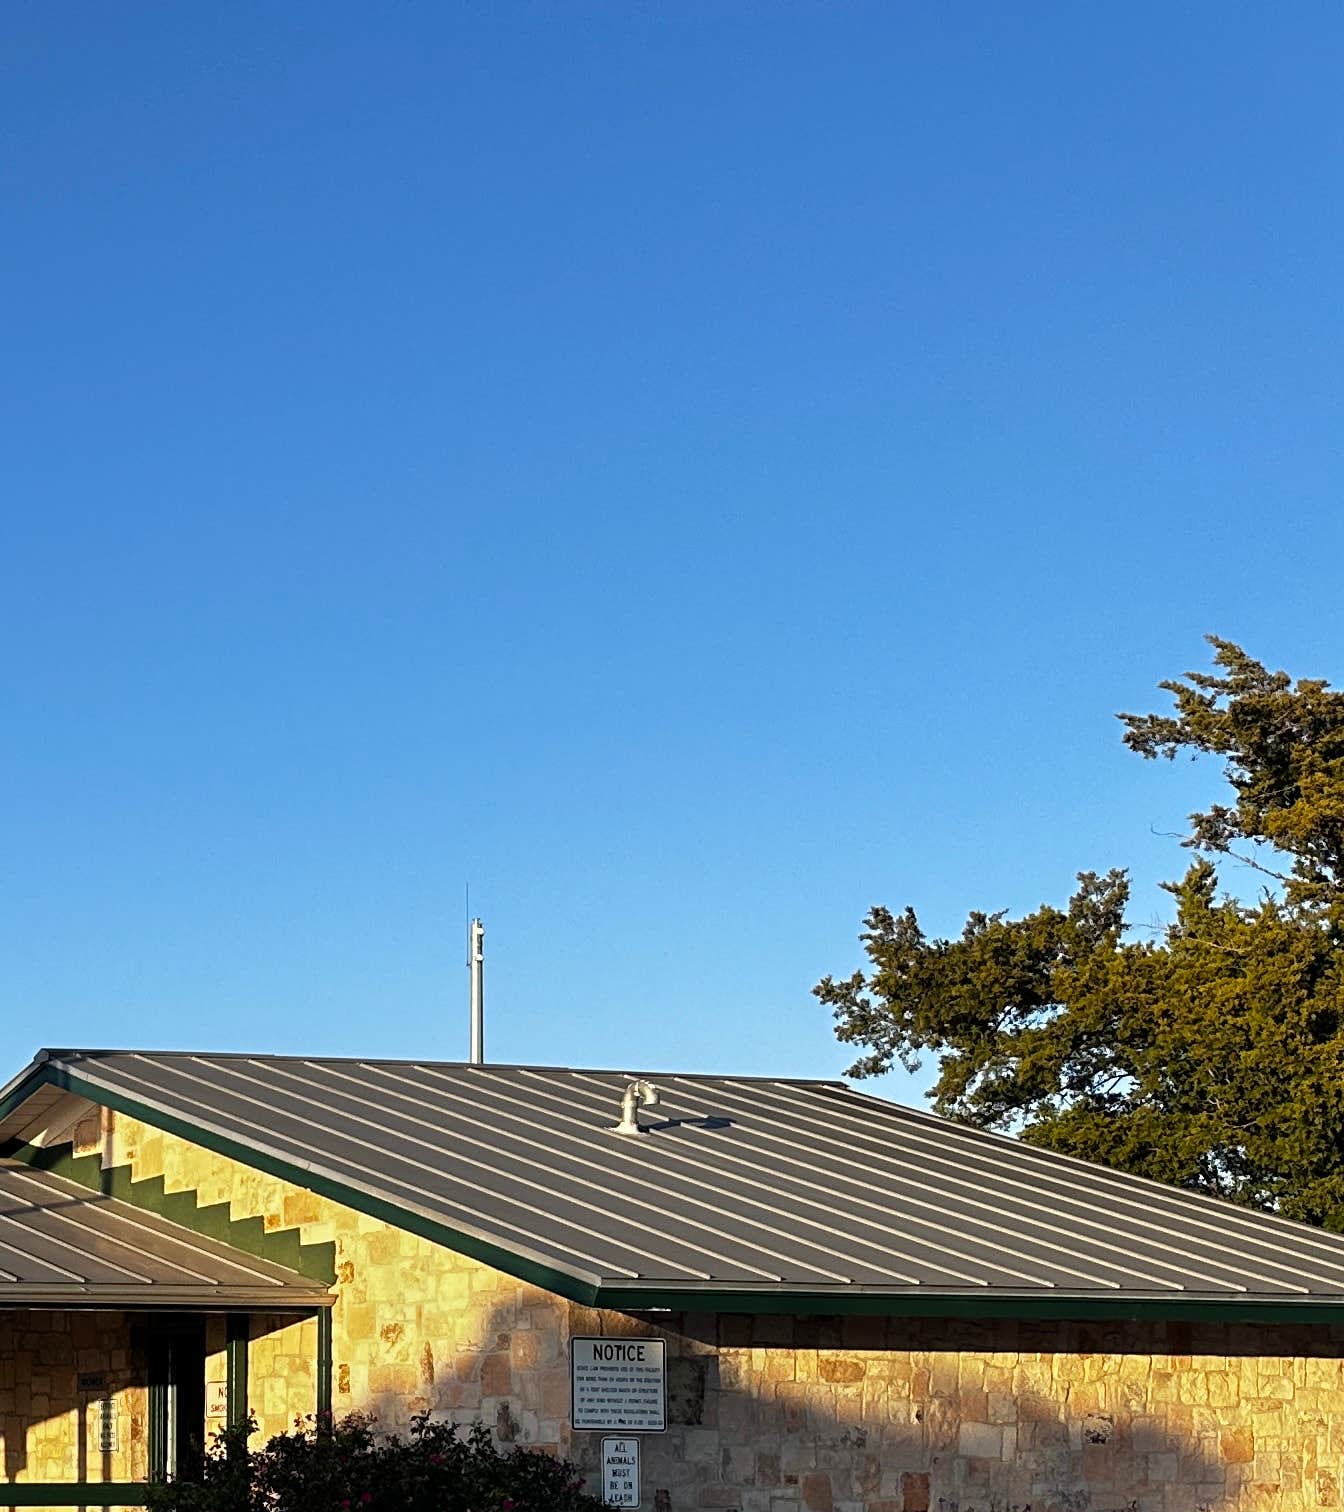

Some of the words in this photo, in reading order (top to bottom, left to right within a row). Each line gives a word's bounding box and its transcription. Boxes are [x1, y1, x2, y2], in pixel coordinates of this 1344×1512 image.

[593, 1344, 645, 1361] NOTICE
[614, 1443, 628, 1453] ALL
[607, 1456, 636, 1465] ANIMALS
[612, 1469, 631, 1477] MUST
[610, 1481, 619, 1489] BE
